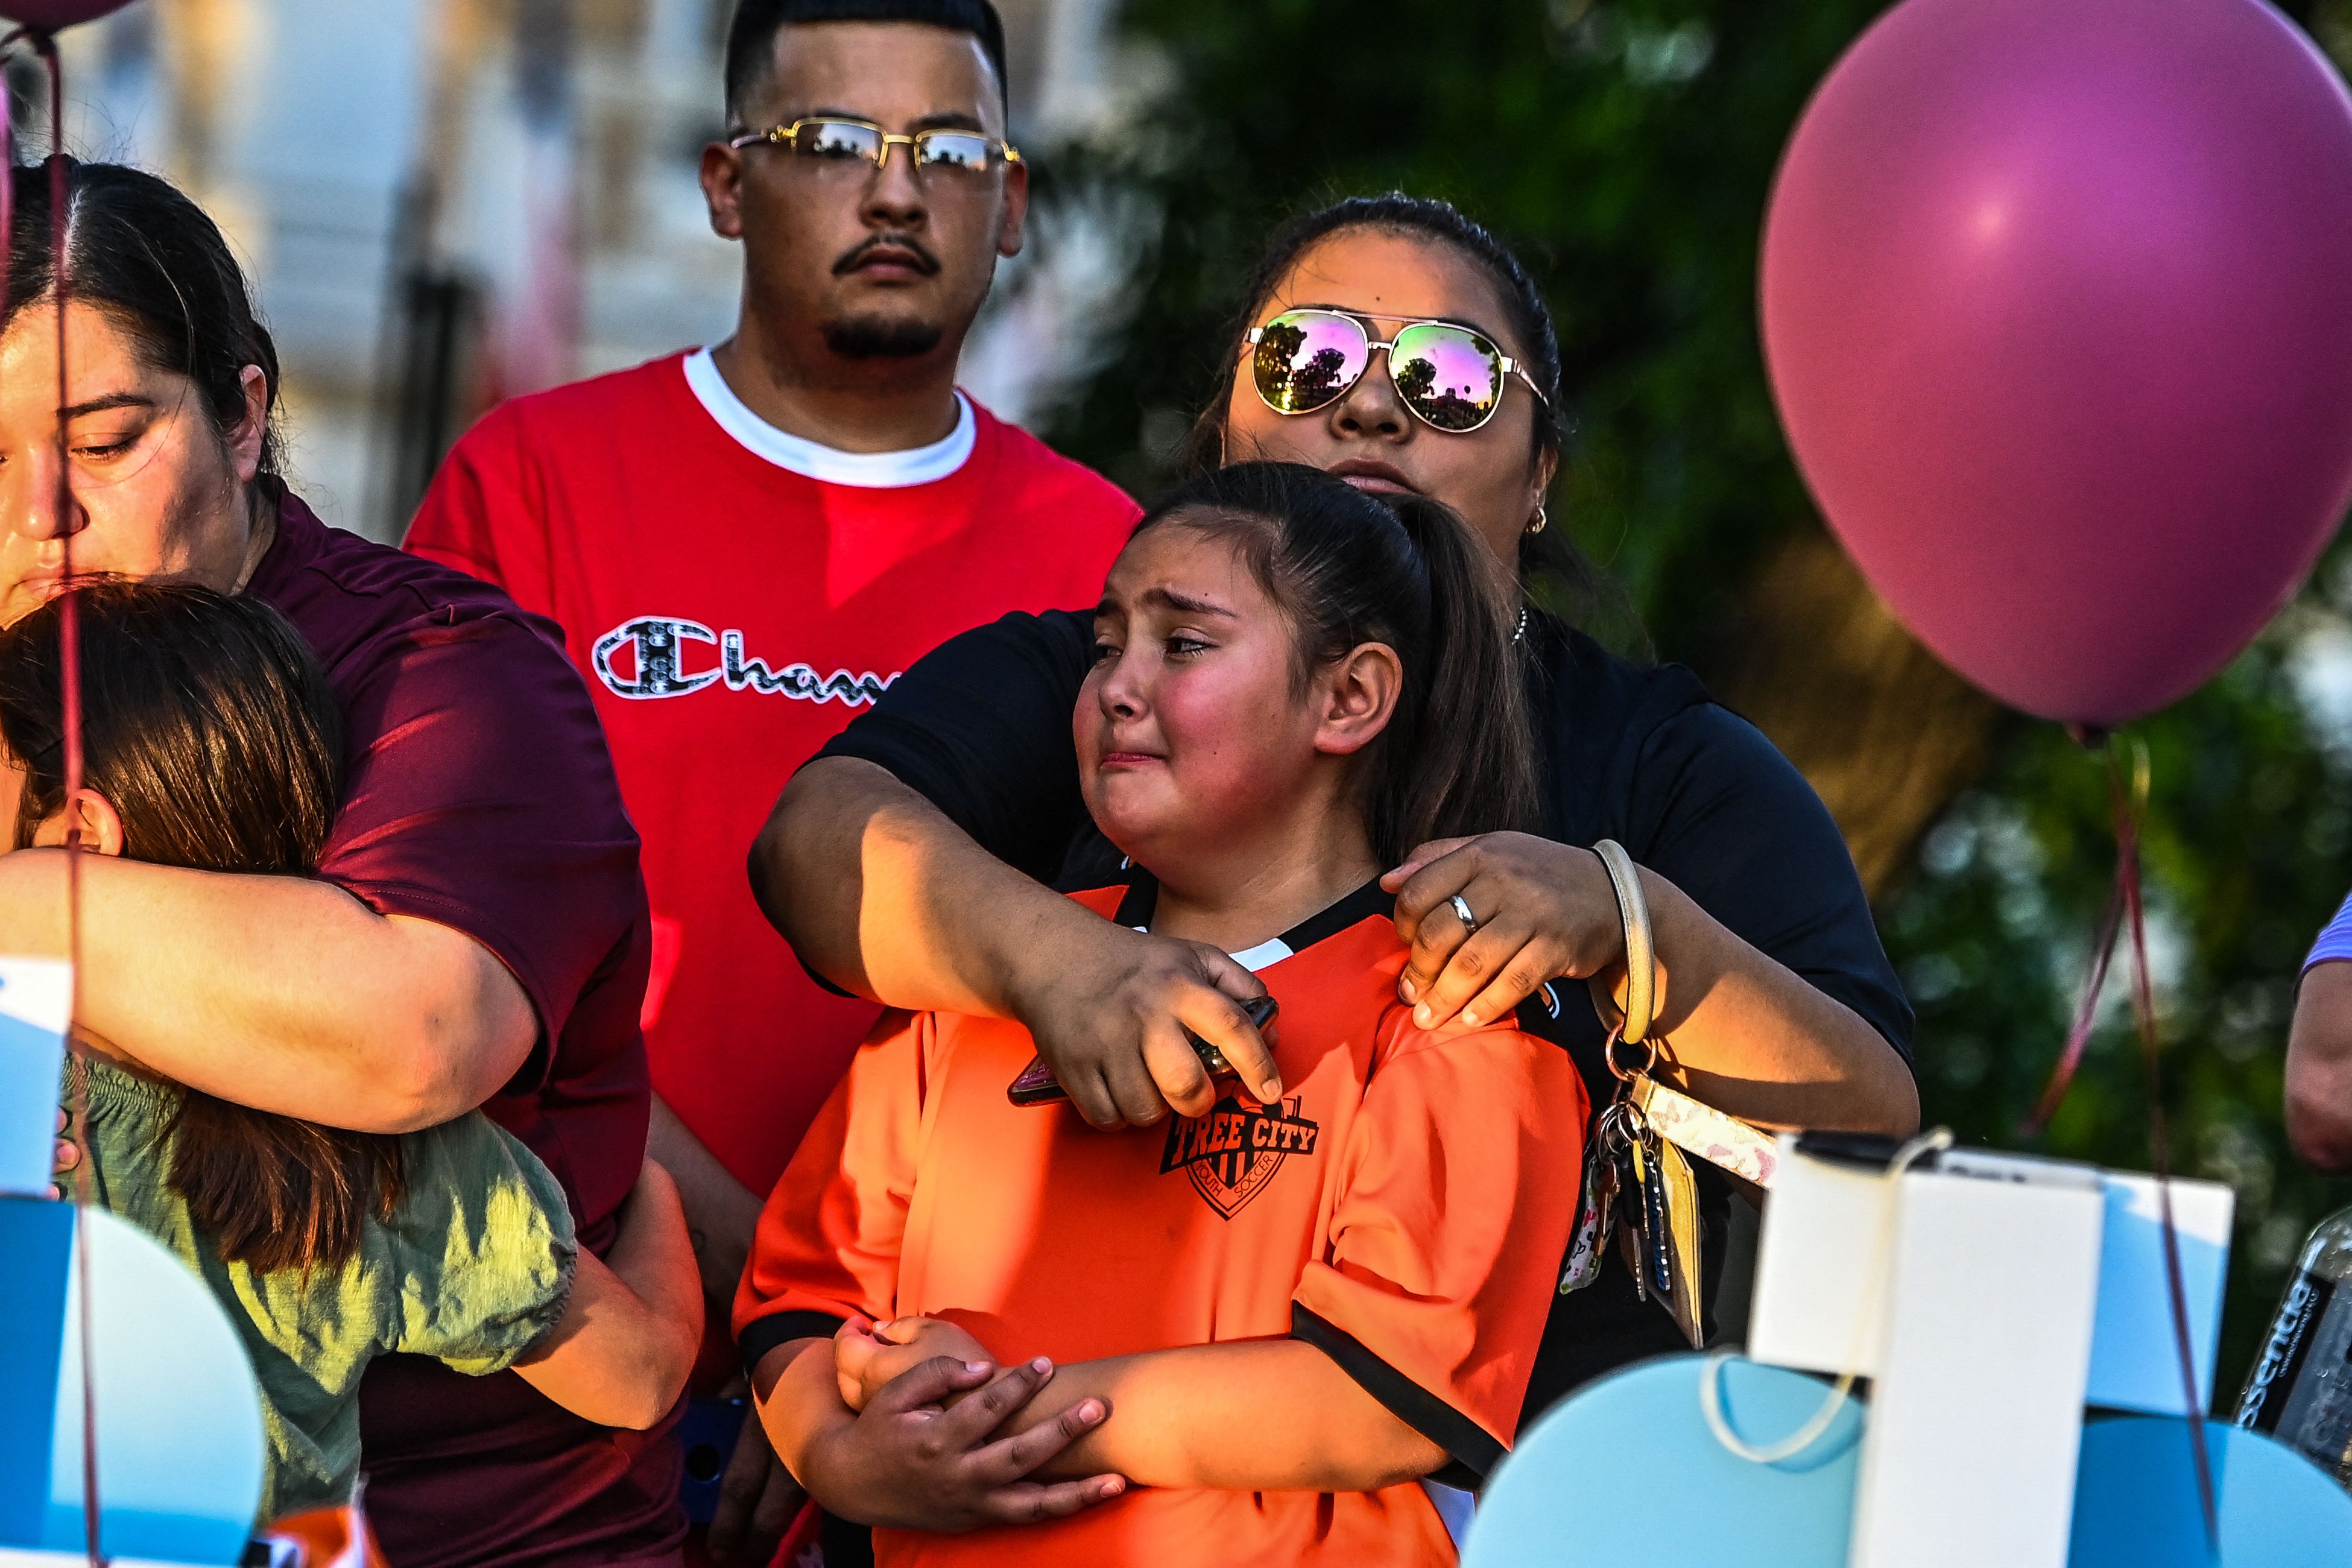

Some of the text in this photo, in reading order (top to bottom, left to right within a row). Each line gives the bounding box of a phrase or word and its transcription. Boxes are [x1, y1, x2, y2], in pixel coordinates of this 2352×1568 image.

[591, 615, 903, 708] Cham
[1171, 1113, 1317, 1166] TREE CITY
[1196, 1154, 1274, 1198] YOUTH SOCCER
[2237, 1280, 2313, 1429] ssentia
